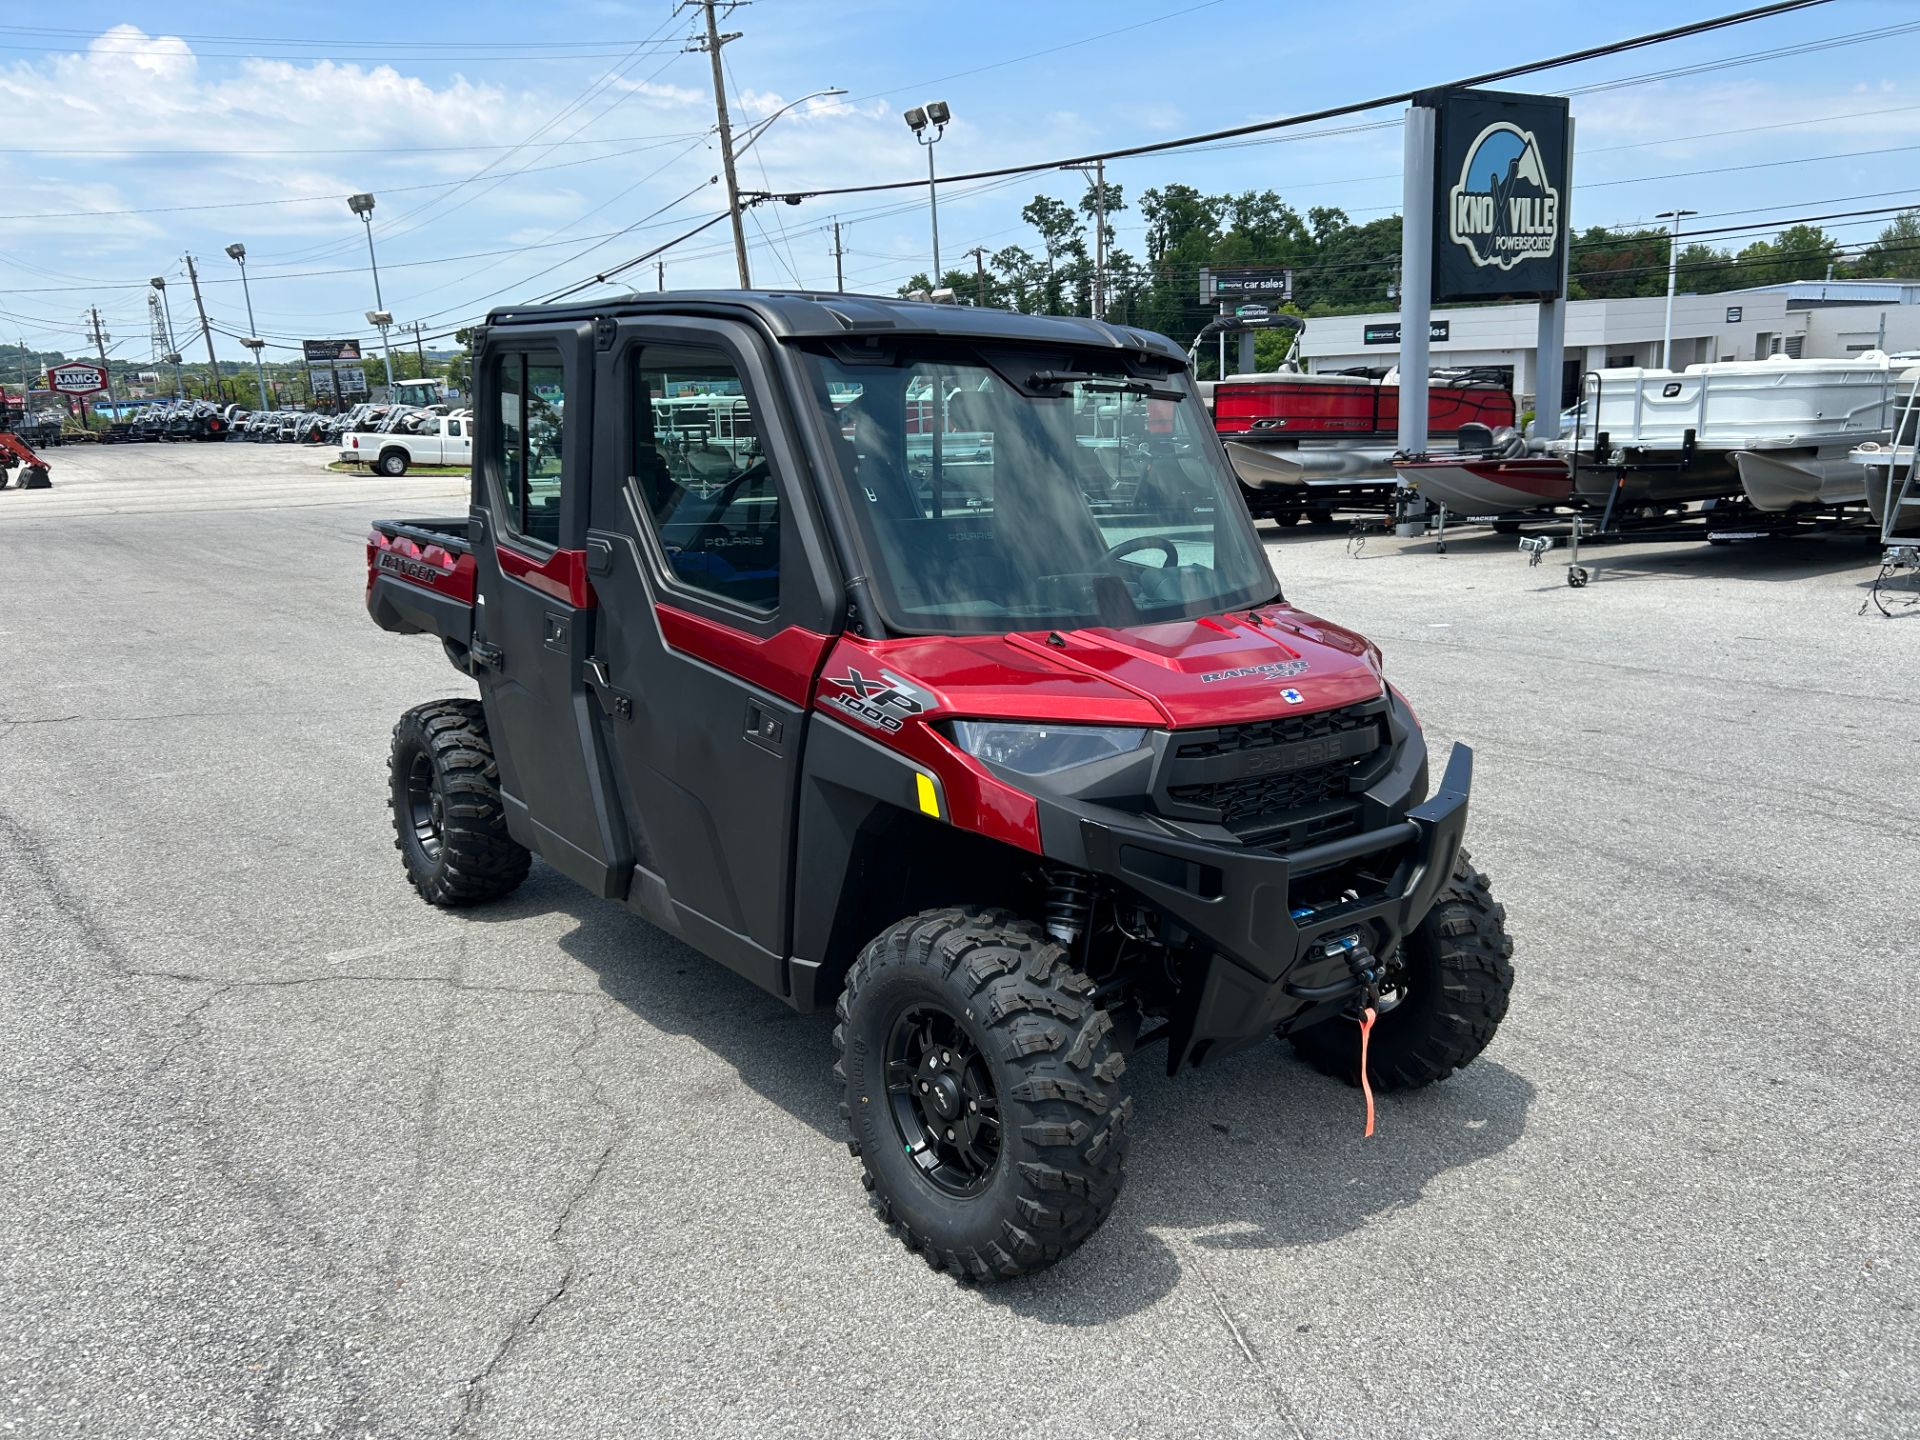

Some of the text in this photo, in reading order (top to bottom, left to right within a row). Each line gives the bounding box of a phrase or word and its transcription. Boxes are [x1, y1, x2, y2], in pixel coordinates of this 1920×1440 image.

[1495, 236, 1552, 251] POWERSPORTS
[1244, 281, 1258, 289] car
[1260, 278, 1284, 289] sales
[55, 374, 102, 385] AAMCO
[704, 536, 764, 548] POLARIS
[381, 553, 436, 584] RANGER
[1200, 660, 1311, 683] RANGER
[826, 666, 923, 714] XP
[838, 692, 904, 732] 1000
